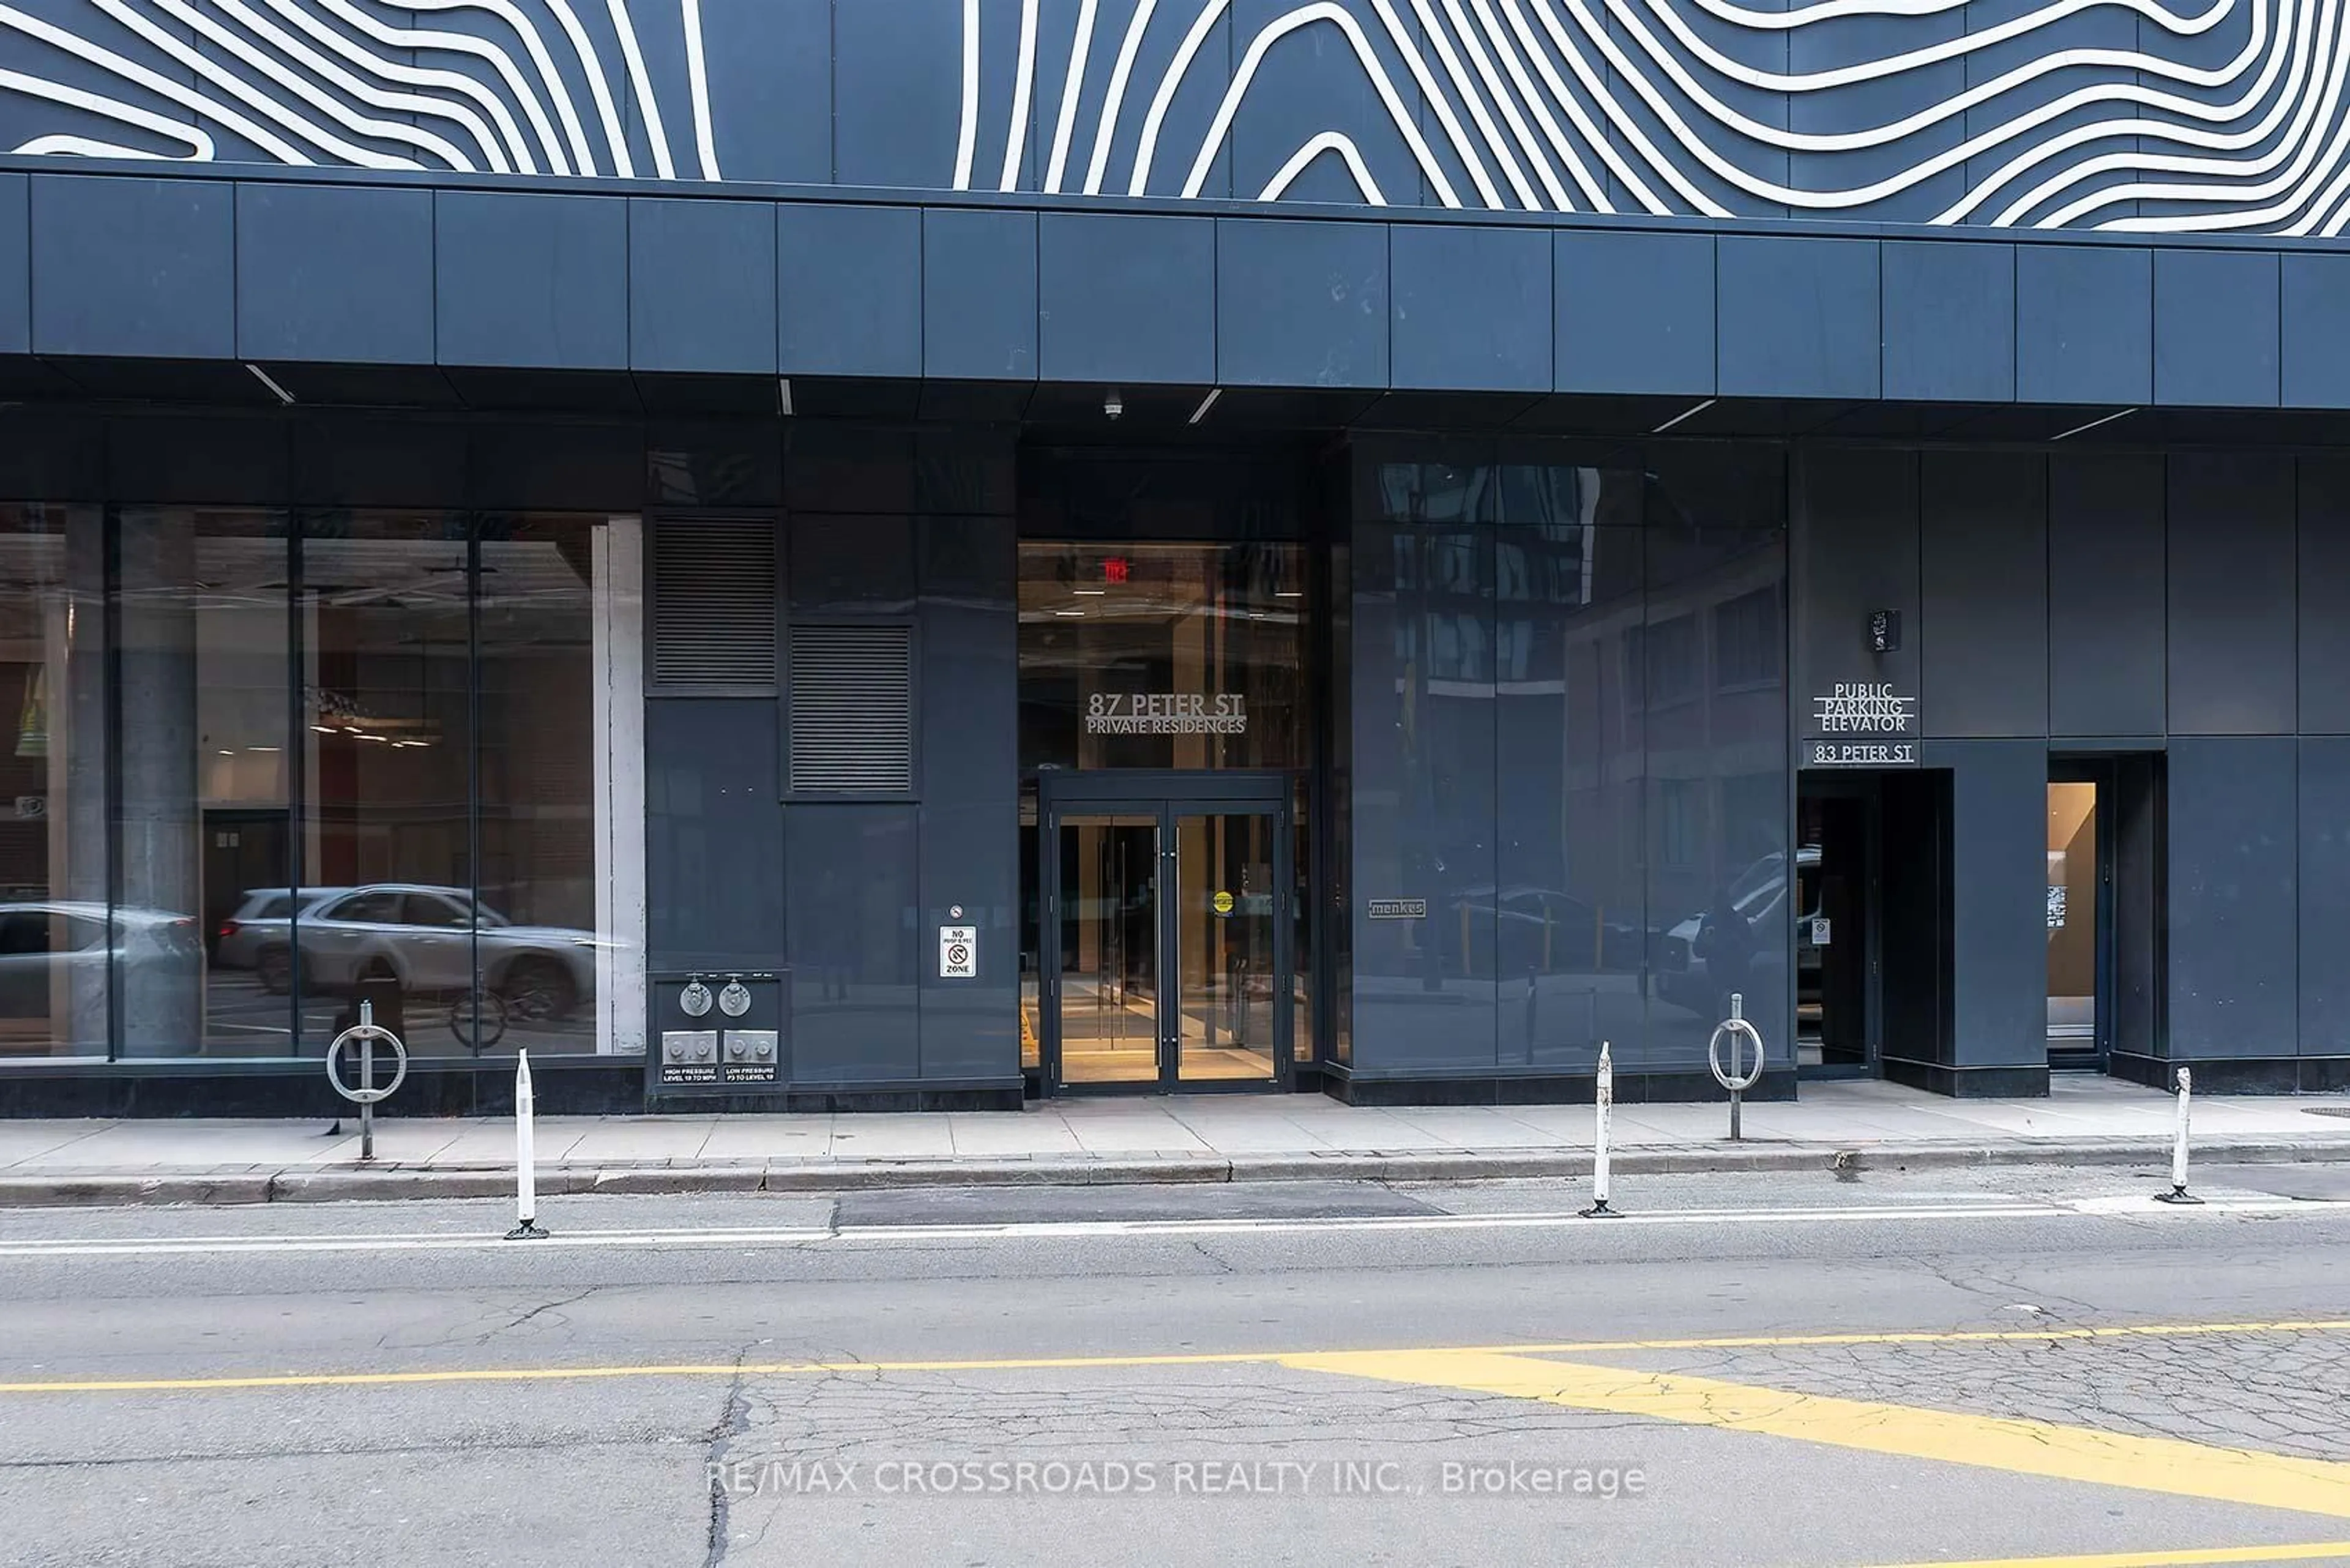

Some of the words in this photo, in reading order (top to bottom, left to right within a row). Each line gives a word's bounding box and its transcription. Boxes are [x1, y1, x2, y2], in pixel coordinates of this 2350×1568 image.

[1835, 684, 1892, 698] PUBLIC
[1089, 694, 1122, 715] 87
[1133, 694, 1204, 715] PETER
[1215, 694, 1244, 715] ST
[1825, 700, 1903, 715] PARKING
[1088, 719, 1147, 734] PRIVATE
[1153, 719, 1245, 734] RESIDENCES
[1822, 717, 1905, 731] ELEVATOR
[1816, 745, 1836, 760] 83
[1842, 745, 1888, 760] PETER
[1894, 745, 1912, 760] ST
[1372, 902, 1423, 914] menkes
